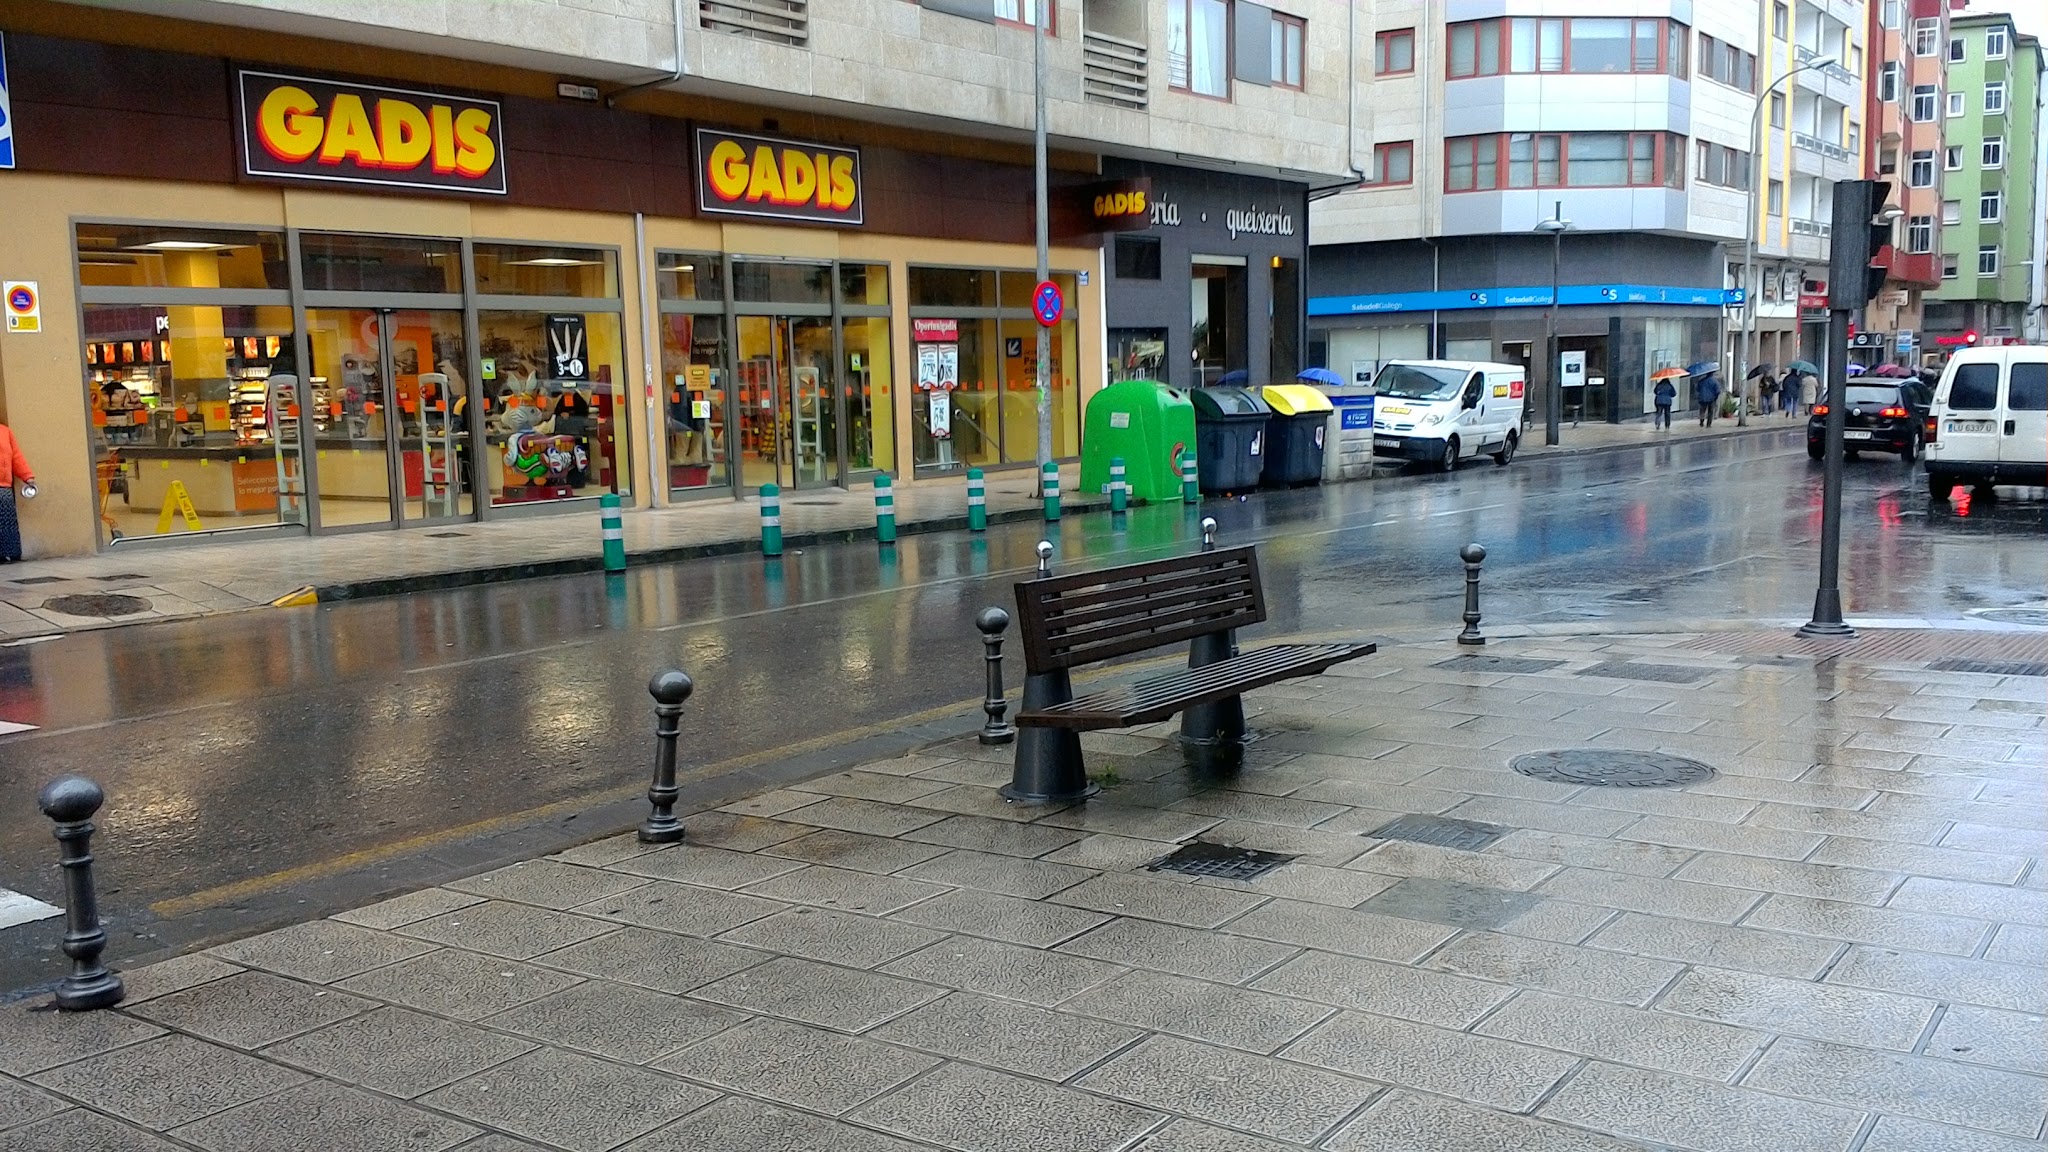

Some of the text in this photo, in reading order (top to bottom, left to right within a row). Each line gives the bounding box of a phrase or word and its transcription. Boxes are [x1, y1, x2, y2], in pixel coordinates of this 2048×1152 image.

[257, 85, 497, 179] GADIS
[708, 139, 857, 212] GADIS
[1094, 191, 1147, 218] GADIS
[1226, 204, 1294, 240] queixería
